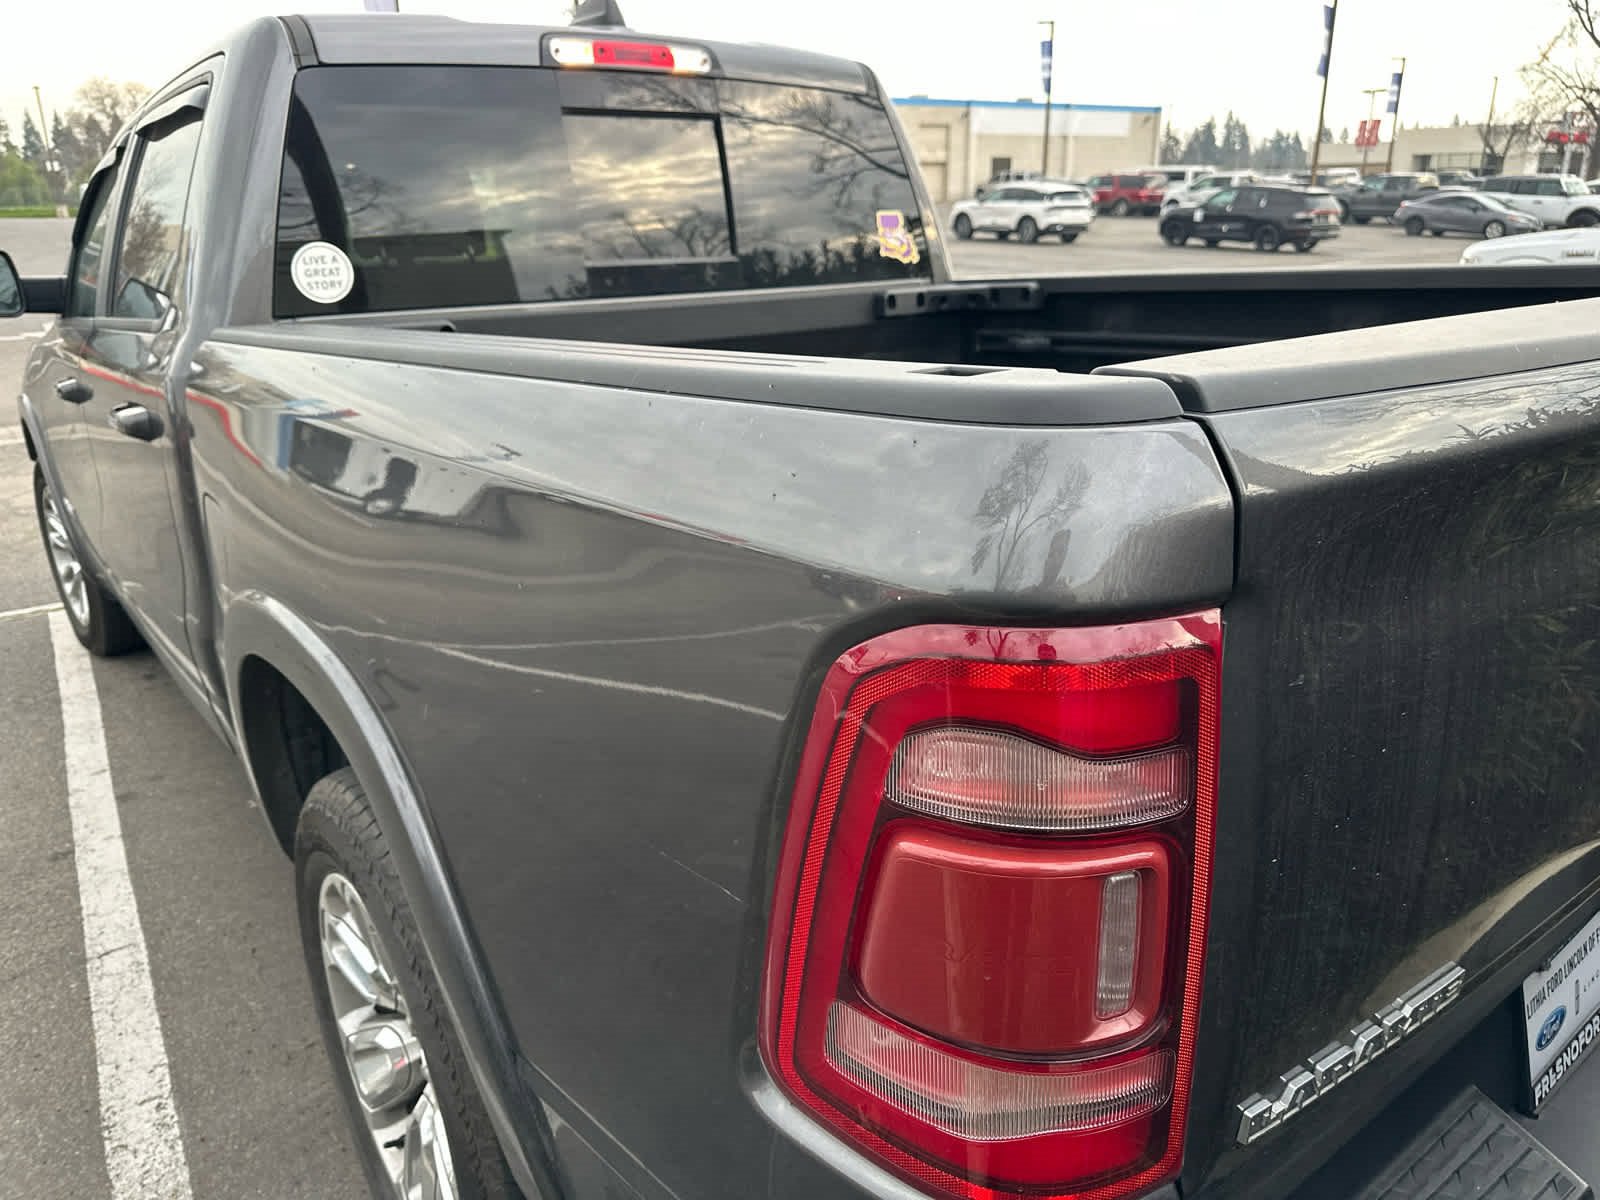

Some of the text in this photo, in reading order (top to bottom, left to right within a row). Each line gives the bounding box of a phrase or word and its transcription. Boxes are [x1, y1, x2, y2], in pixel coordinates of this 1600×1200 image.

[302, 255, 339, 265] LIVE A
[304, 267, 341, 278] GREAT
[306, 280, 342, 291] STORY
[1526, 986, 1547, 1020] LITHIA
[1546, 967, 1564, 998] FORD
[1563, 940, 1588, 979] LINCOLN
[1587, 931, 1596, 953] OF
